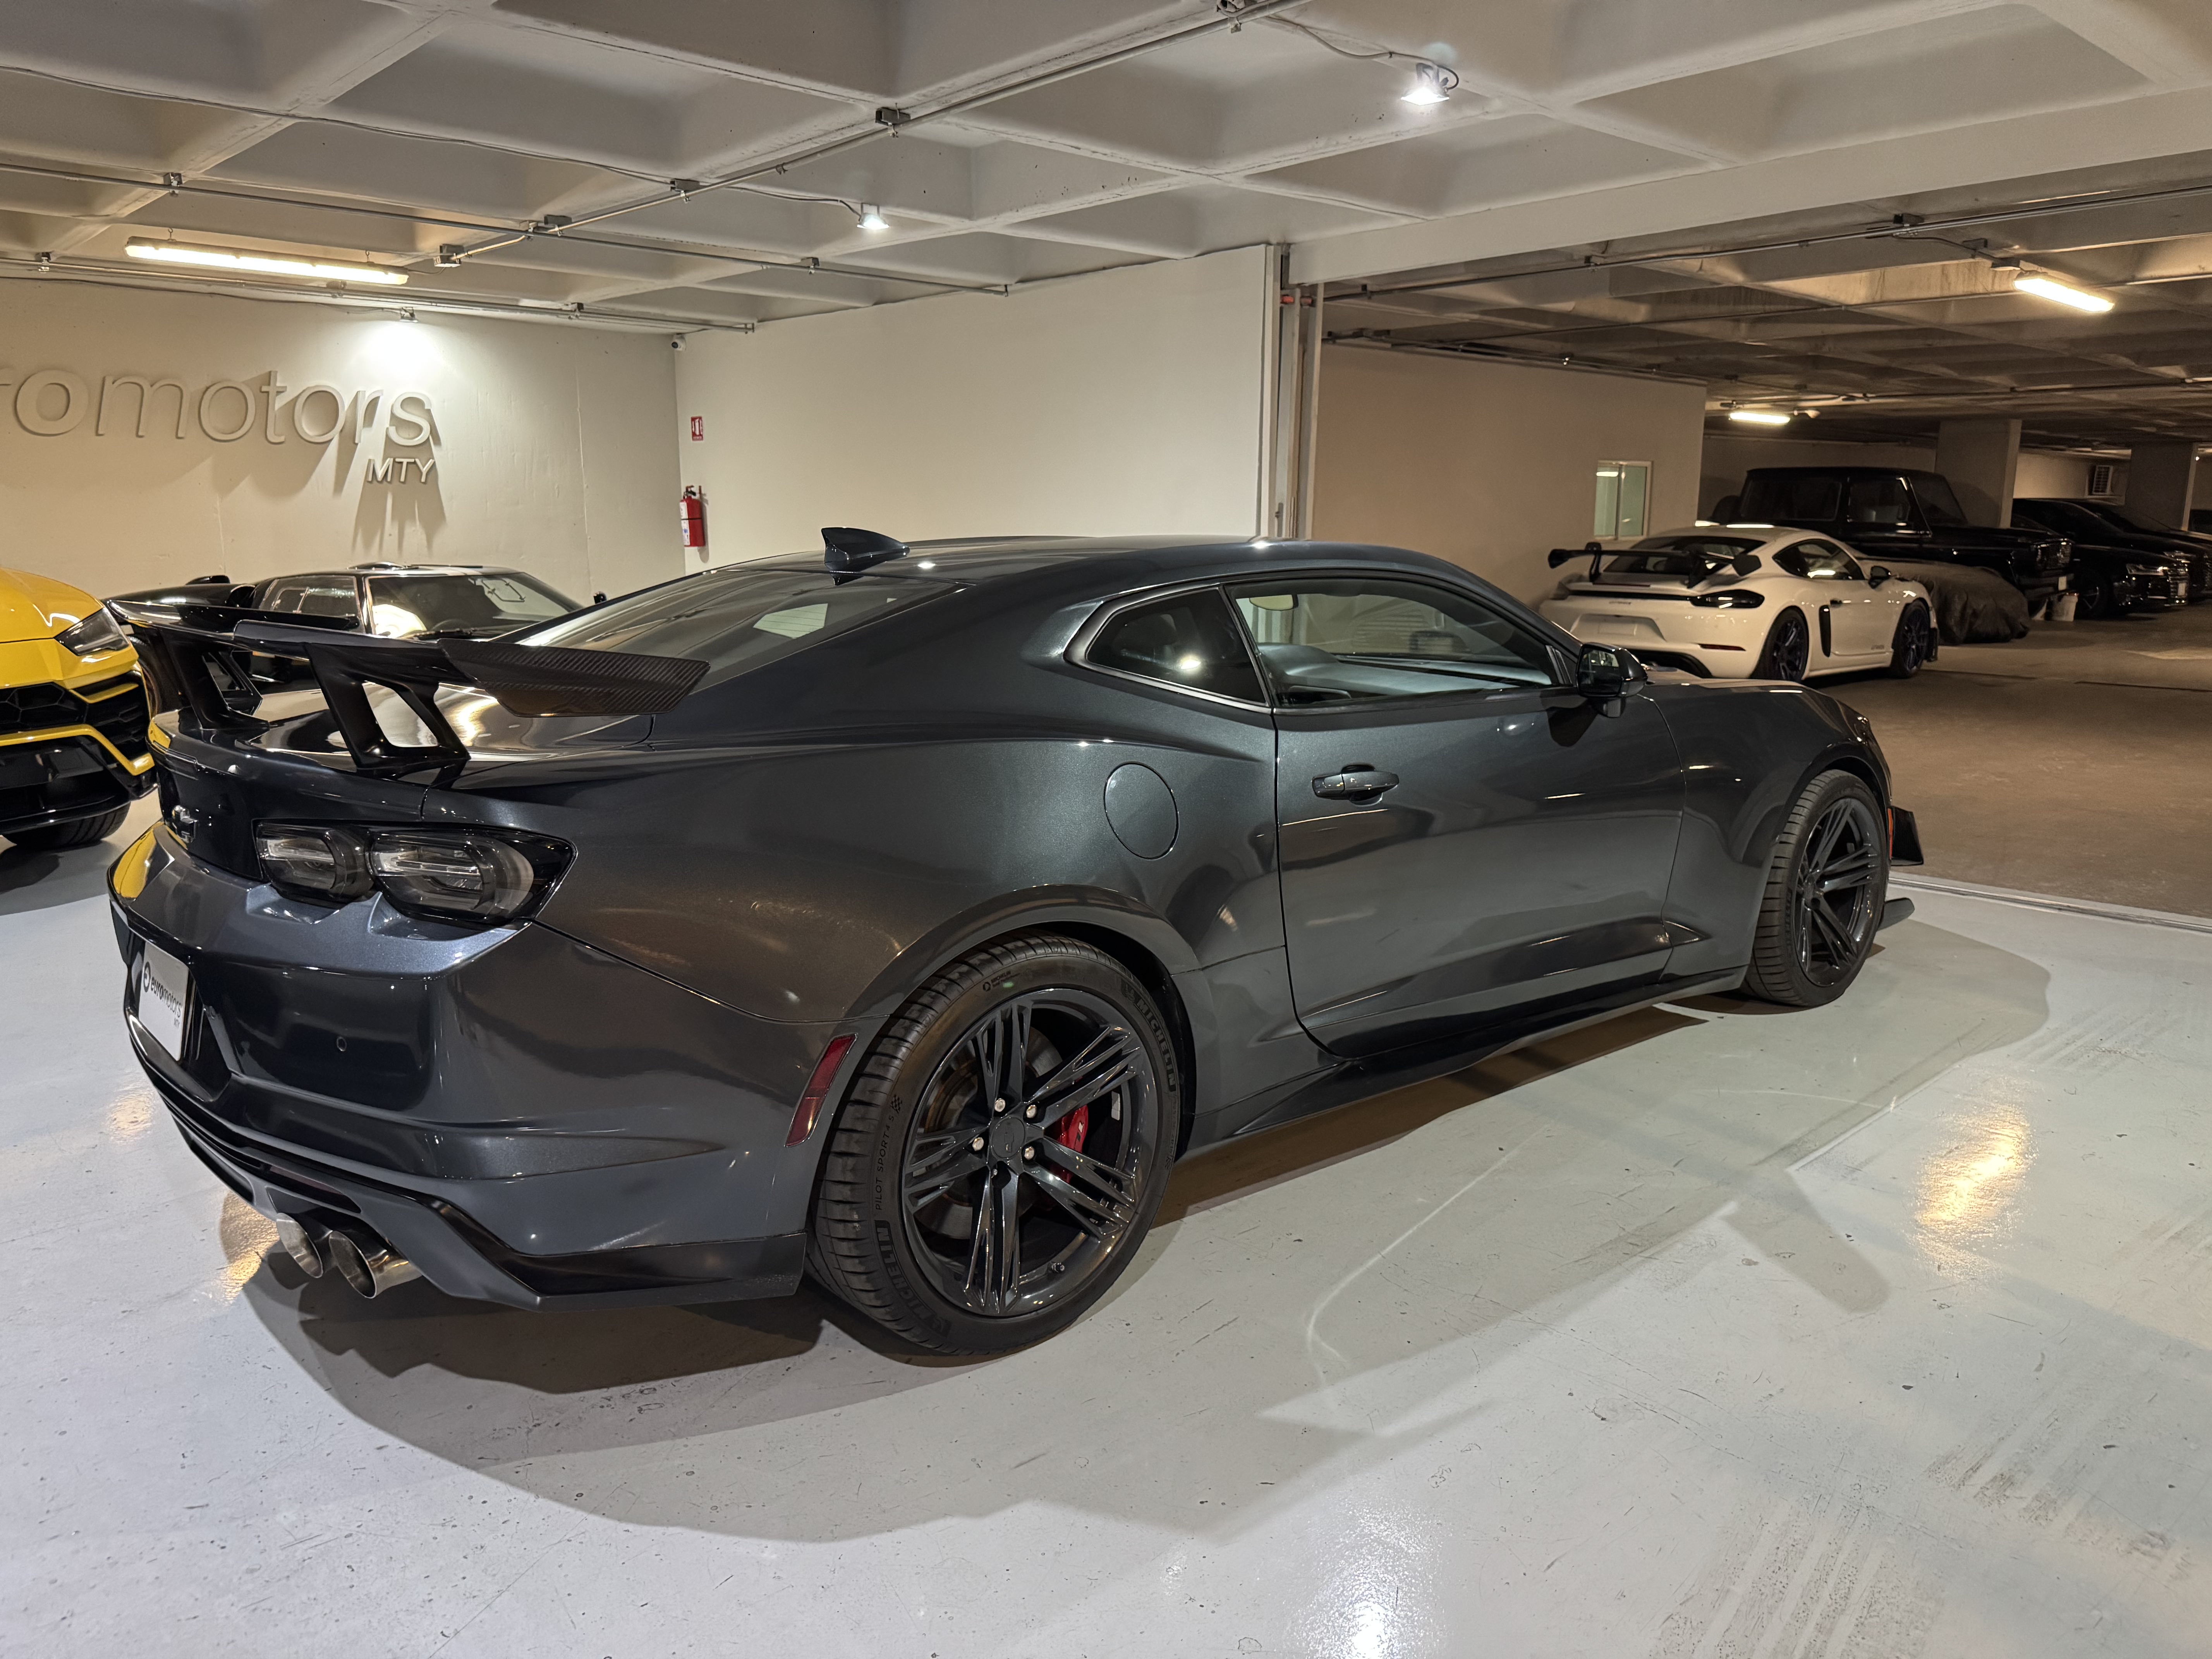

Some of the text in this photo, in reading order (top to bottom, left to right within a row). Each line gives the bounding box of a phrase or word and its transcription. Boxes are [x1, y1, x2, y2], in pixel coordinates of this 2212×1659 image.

[0, 366, 432, 446] omotors
[367, 457, 434, 483] MTY
[150, 975, 182, 1018] euromotors
[1137, 998, 1176, 1085] MICHELIN
[877, 1132, 890, 1172] SPORT
[877, 1227, 933, 1320] MICHELIN
